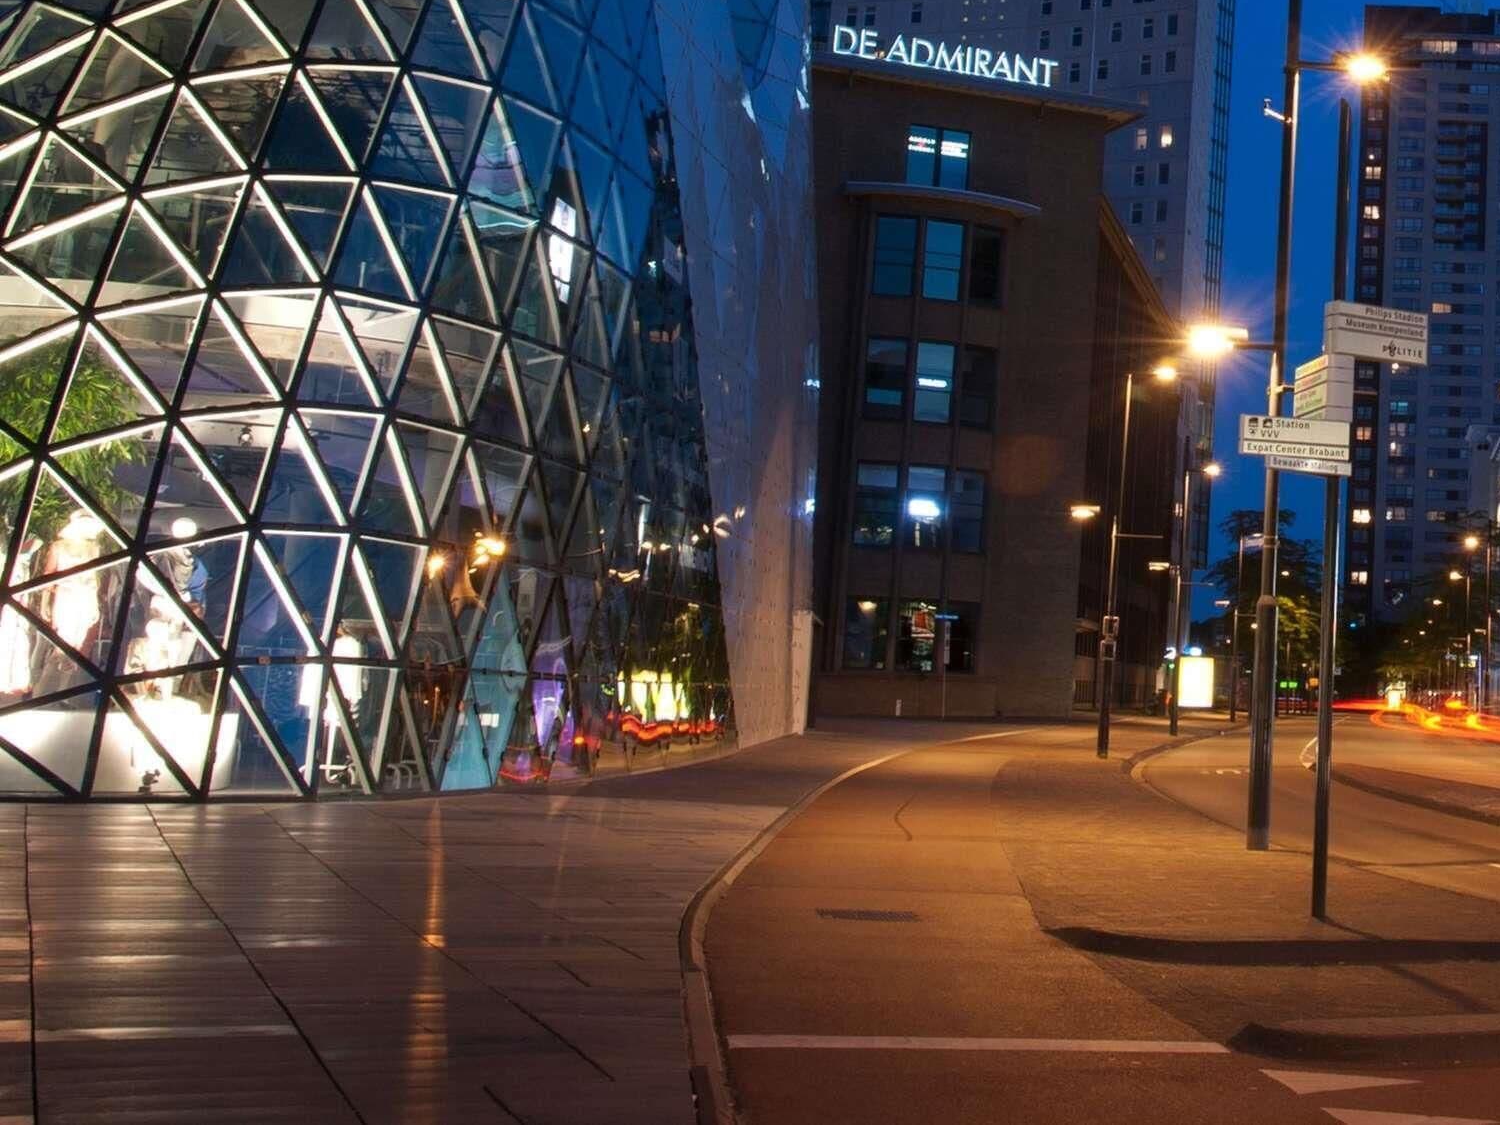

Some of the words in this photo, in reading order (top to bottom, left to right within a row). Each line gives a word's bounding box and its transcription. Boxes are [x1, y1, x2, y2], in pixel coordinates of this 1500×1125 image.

[833, 25, 878, 60] DE
[884, 34, 1058, 87] ADMIRANT
[1365, 307, 1391, 319] Philips
[1394, 311, 1424, 324] Stadion
[1346, 318, 1377, 330] Museum
[1276, 420, 1310, 429] Station
[1260, 430, 1280, 438] VVV
[1247, 443, 1273, 454] Expat
[1275, 445, 1306, 454] Center
[1309, 448, 1345, 458] Brabant
